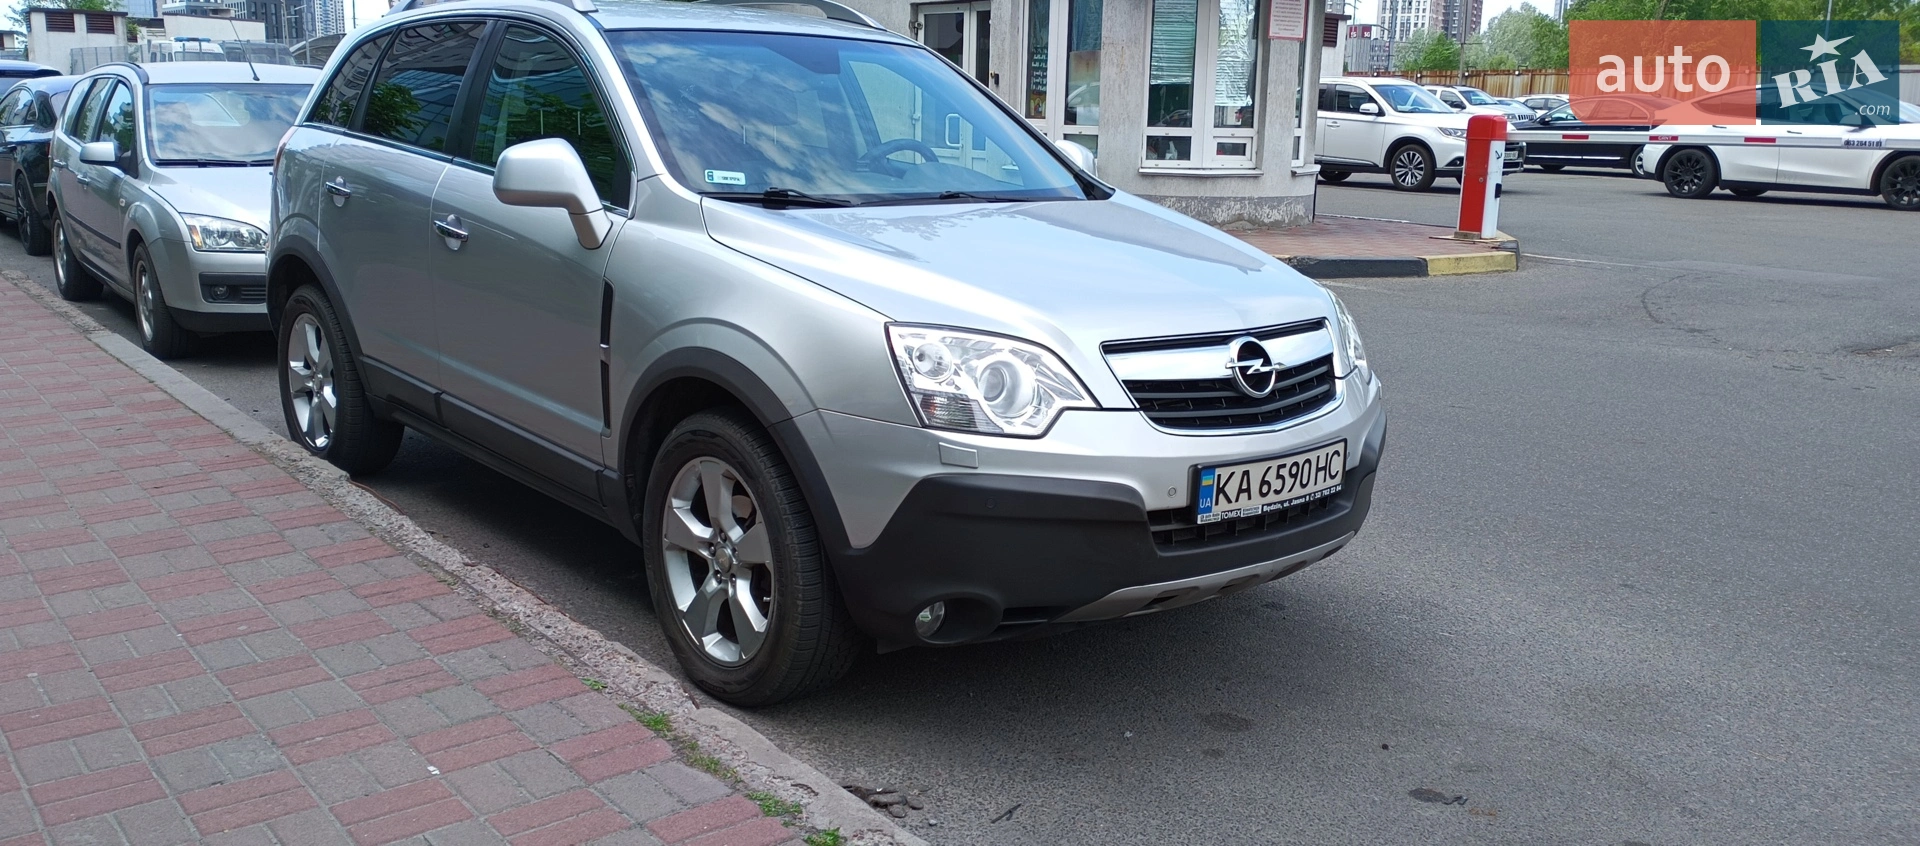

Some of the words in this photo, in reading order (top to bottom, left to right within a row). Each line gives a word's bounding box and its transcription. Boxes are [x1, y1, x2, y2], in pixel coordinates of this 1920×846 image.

[1214, 469, 1252, 506] KA
[1258, 458, 1312, 498] 6590
[1314, 450, 1341, 486] HC
[1199, 498, 1211, 508] UA
[1221, 510, 1241, 519] TOMEX
